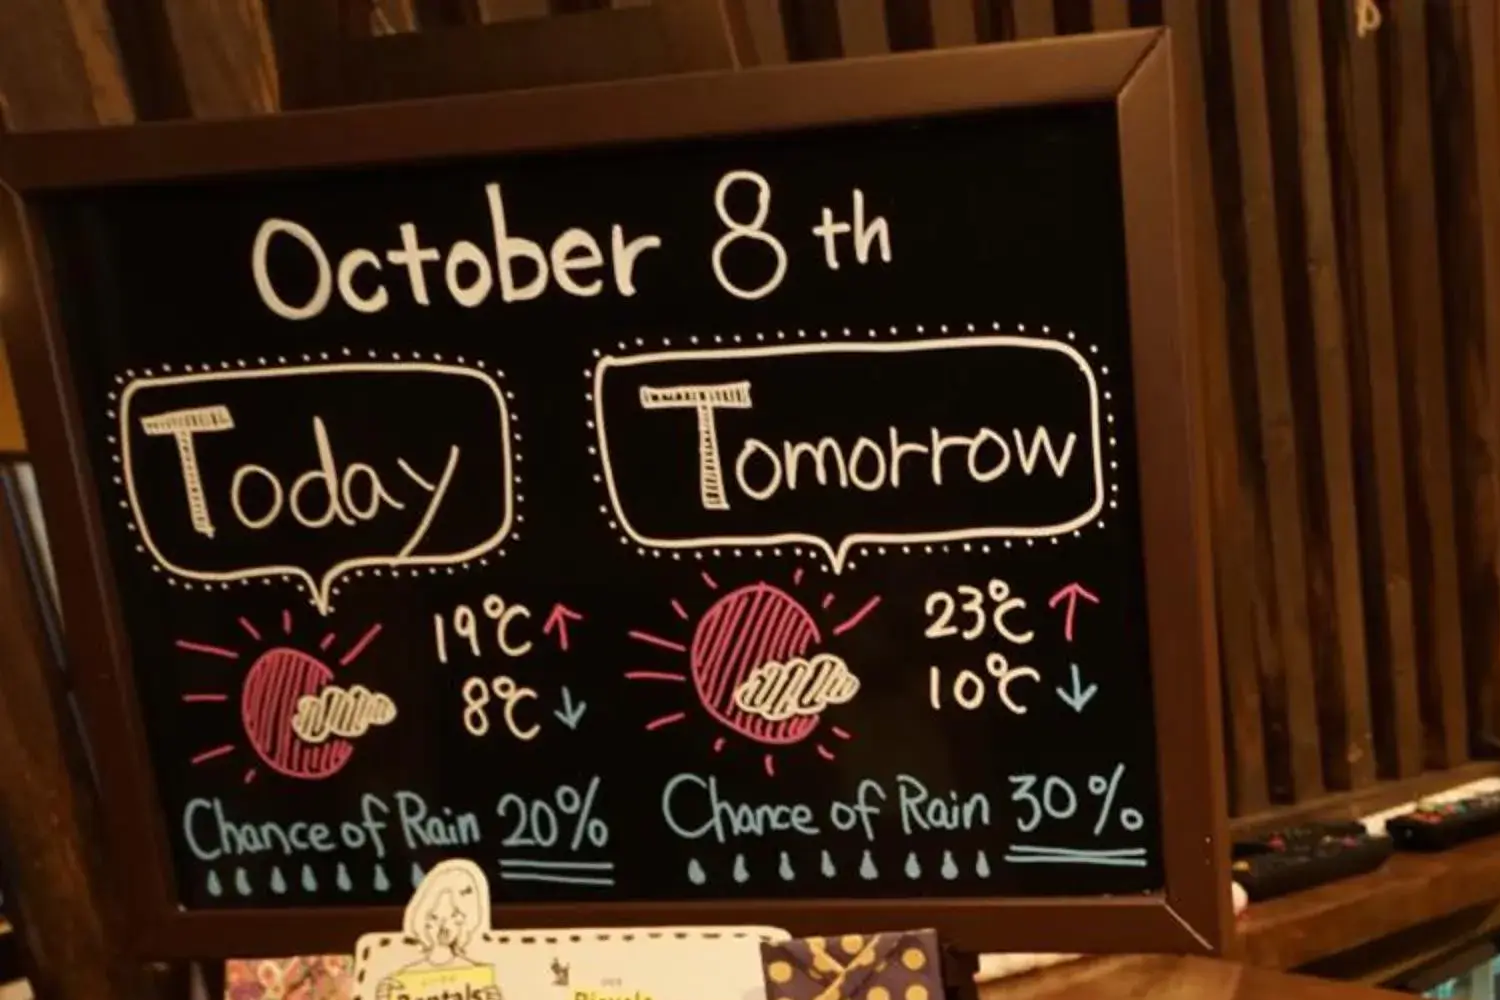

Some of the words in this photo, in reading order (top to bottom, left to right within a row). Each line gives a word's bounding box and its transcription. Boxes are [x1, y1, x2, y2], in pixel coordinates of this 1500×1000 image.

[252, 182, 661, 320] October
[711, 169, 788, 300] 8
[812, 187, 893, 269] th
[139, 403, 460, 563] Today
[638, 381, 1076, 509] Tomorrow
[183, 799, 336, 861] Chance
[345, 793, 390, 857] of
[396, 791, 481, 849] Rain
[497, 776, 609, 851] 20%
[662, 773, 820, 843] Chance
[831, 780, 886, 840] of
[896, 774, 991, 835] Rain
[1008, 763, 1144, 835] 30%
